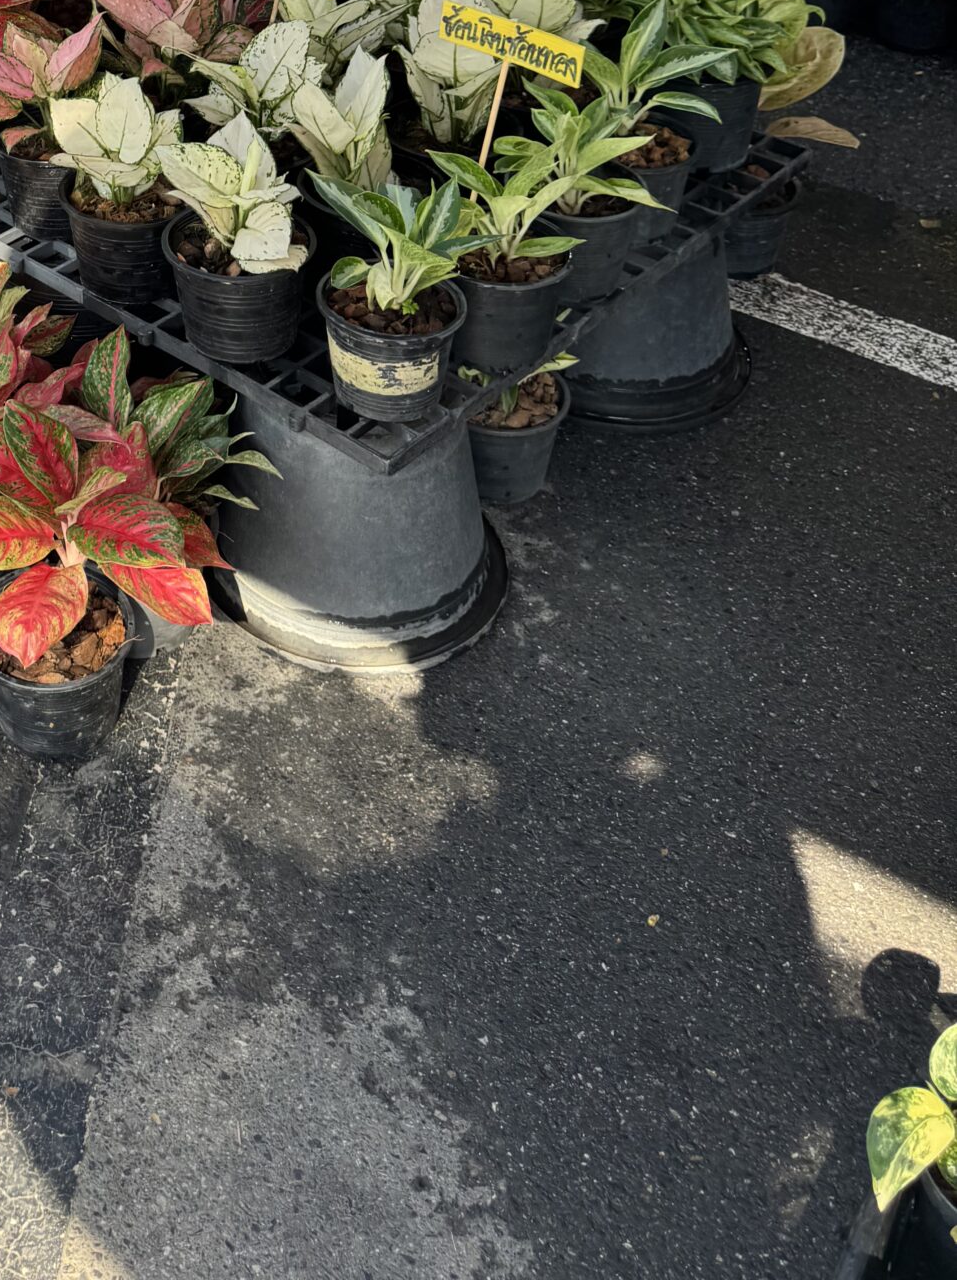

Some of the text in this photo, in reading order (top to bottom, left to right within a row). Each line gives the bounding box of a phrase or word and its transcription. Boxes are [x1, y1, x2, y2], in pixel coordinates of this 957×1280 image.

[442, 5, 578, 82] ช้อนเงินช้อนทอง
